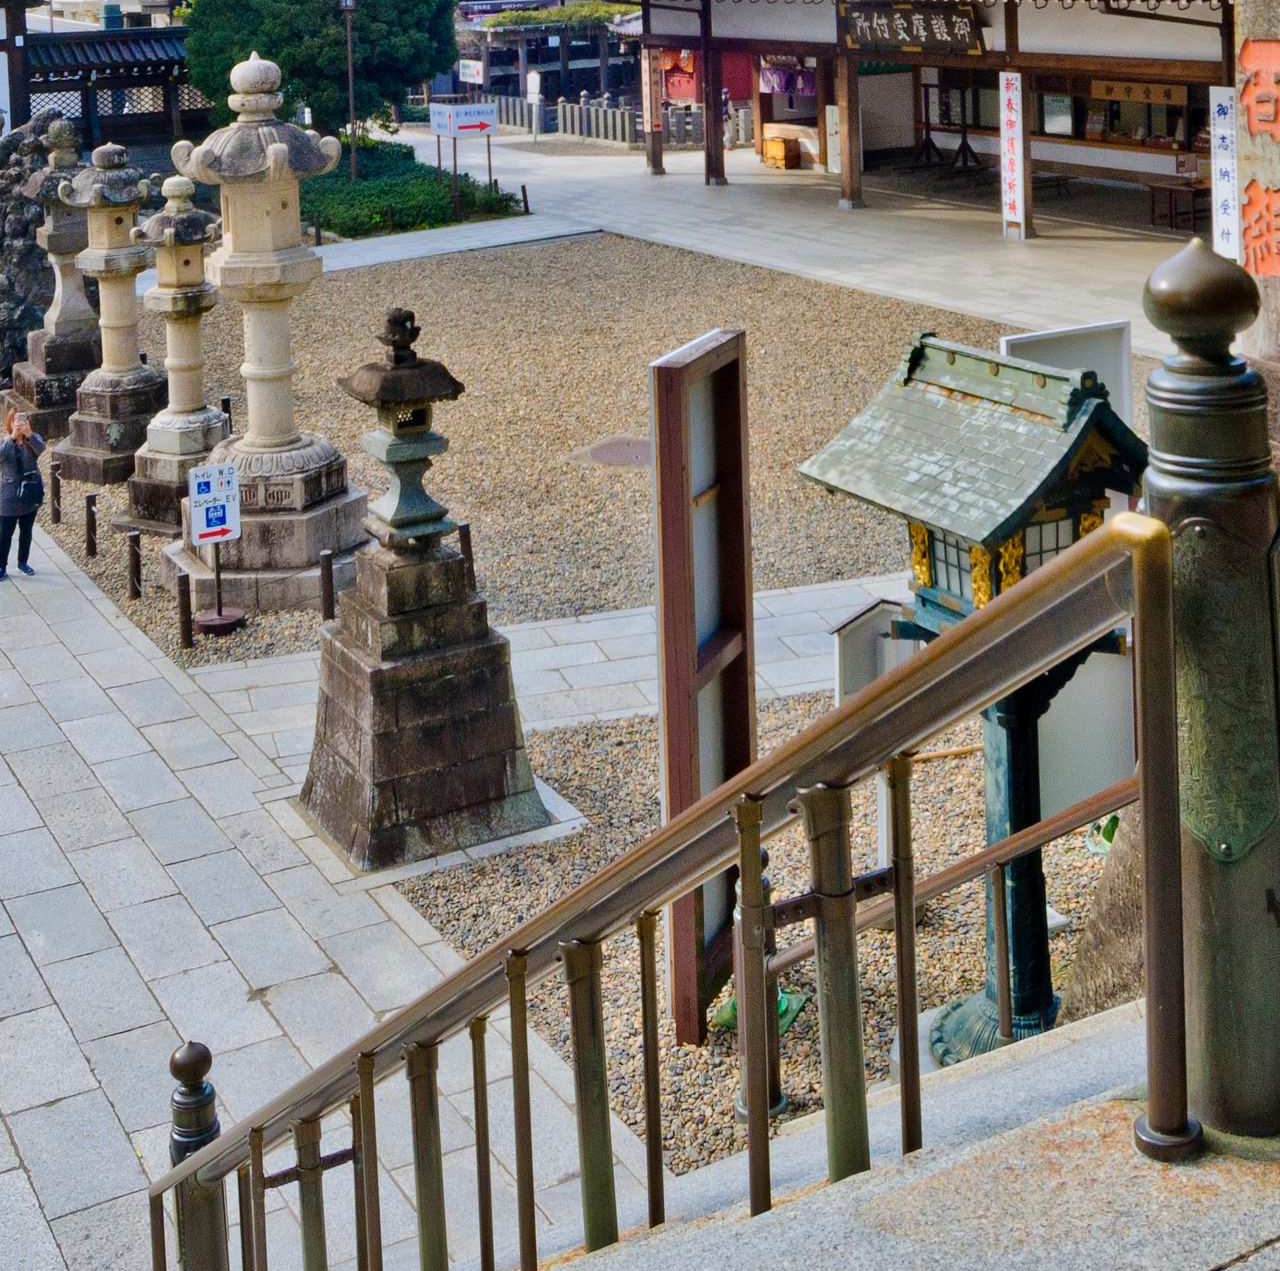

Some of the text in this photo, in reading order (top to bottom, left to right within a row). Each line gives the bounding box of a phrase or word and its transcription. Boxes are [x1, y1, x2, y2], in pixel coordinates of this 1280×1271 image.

[852, 12, 971, 42] 御護摩受付所
[1216, 103, 1232, 244] 御志納受付
[194, 471, 212, 481] トイレ
[193, 493, 237, 508] エレベーター EV
